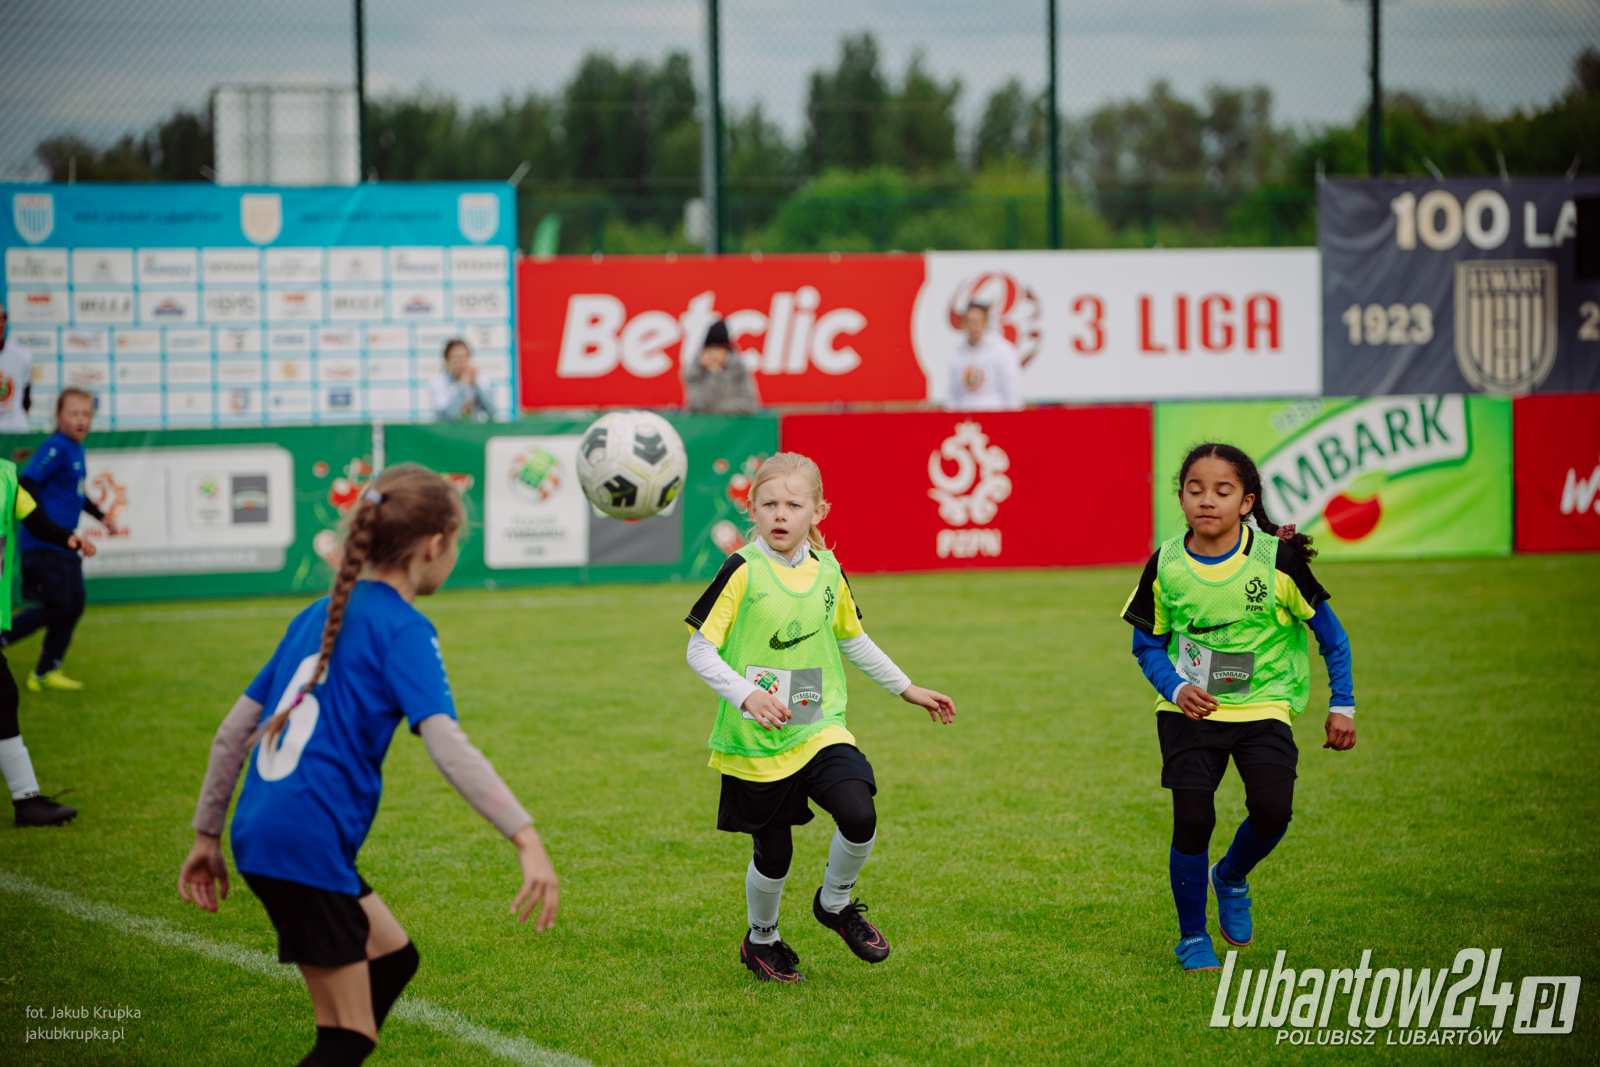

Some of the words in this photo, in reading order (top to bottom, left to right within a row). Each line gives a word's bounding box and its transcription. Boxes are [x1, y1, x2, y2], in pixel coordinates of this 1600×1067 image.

[1391, 189, 1510, 250] 100
[557, 285, 867, 378] Betclic
[1072, 294, 1105, 353] 3
[1138, 294, 1281, 353] LIGA
[1342, 303, 1434, 346] 1923
[1270, 394, 1450, 515] MBARK
